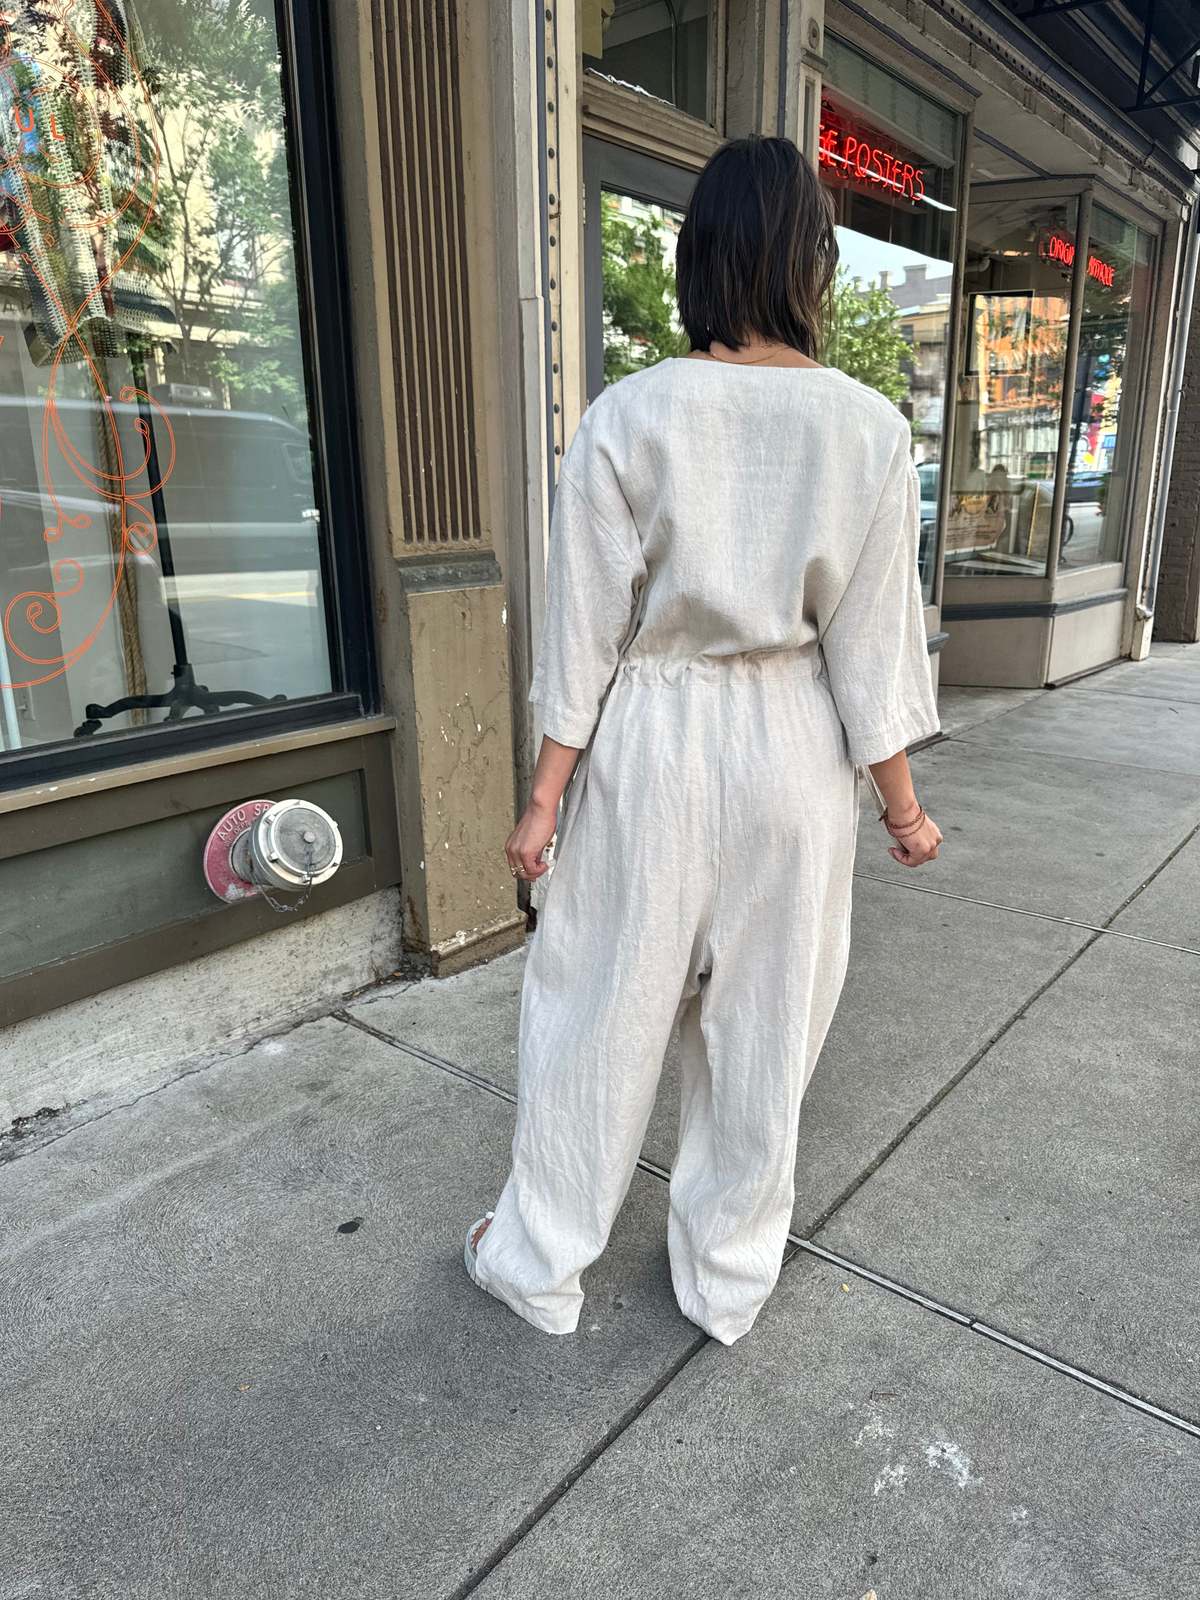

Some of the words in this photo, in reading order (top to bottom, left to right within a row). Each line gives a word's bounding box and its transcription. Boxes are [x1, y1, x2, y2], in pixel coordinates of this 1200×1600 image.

[843, 136, 926, 201] POSTERS
[216, 809, 246, 841] AUTO
[254, 803, 271, 816] SP
